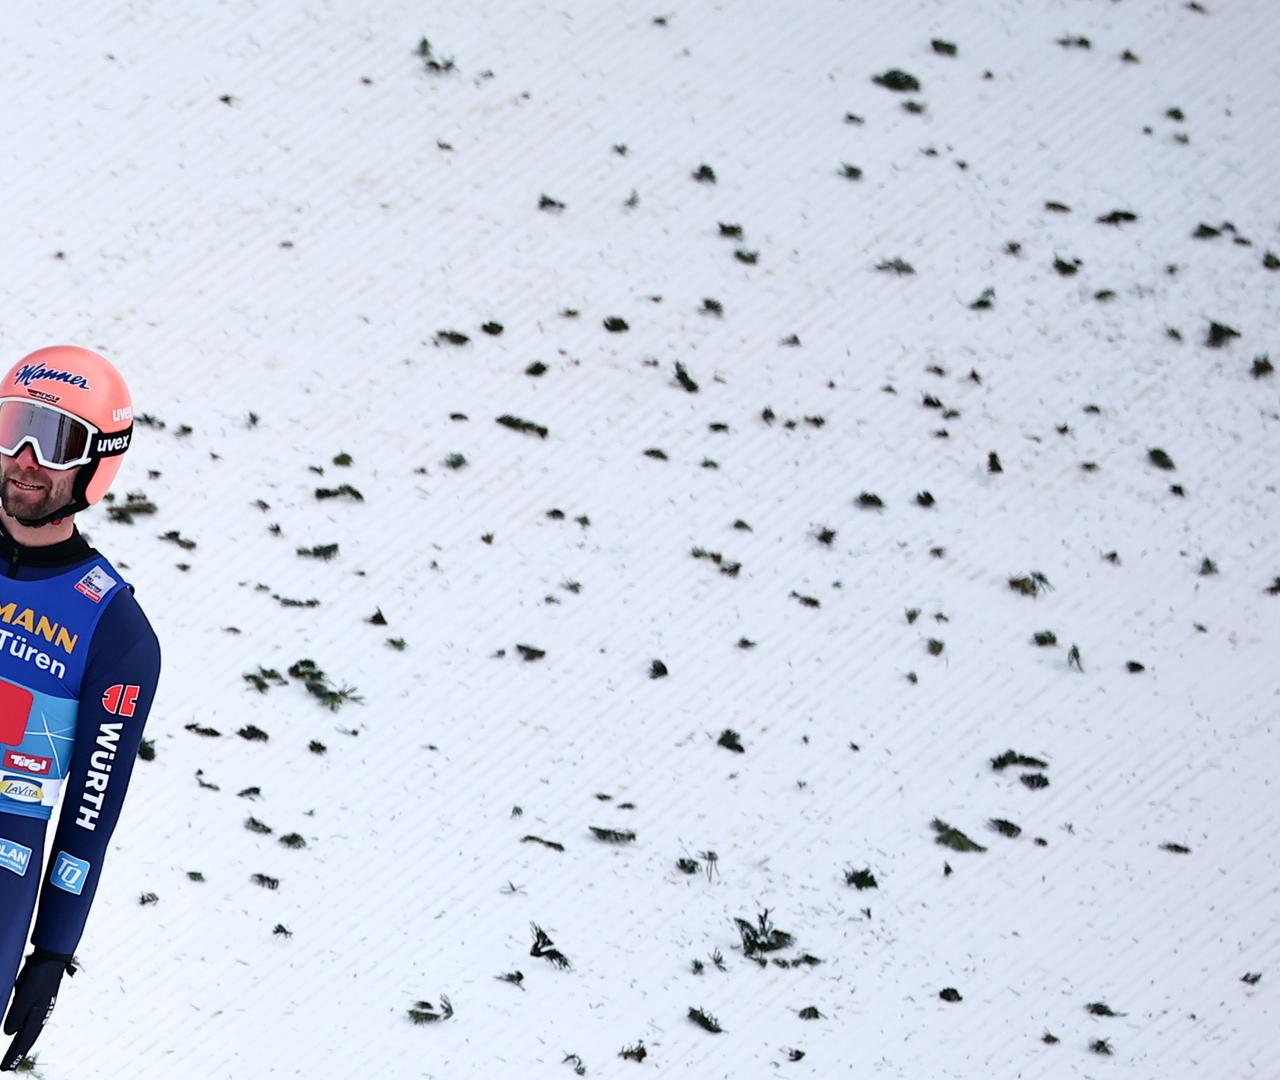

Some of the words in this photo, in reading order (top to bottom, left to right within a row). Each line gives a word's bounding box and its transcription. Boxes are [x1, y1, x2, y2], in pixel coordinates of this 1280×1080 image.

[14, 362, 90, 390] Manner
[97, 434, 130, 453] uvex
[10, 754, 47, 771] Tirol
[75, 722, 123, 831] WÜRTH
[57, 857, 81, 889] TQ
